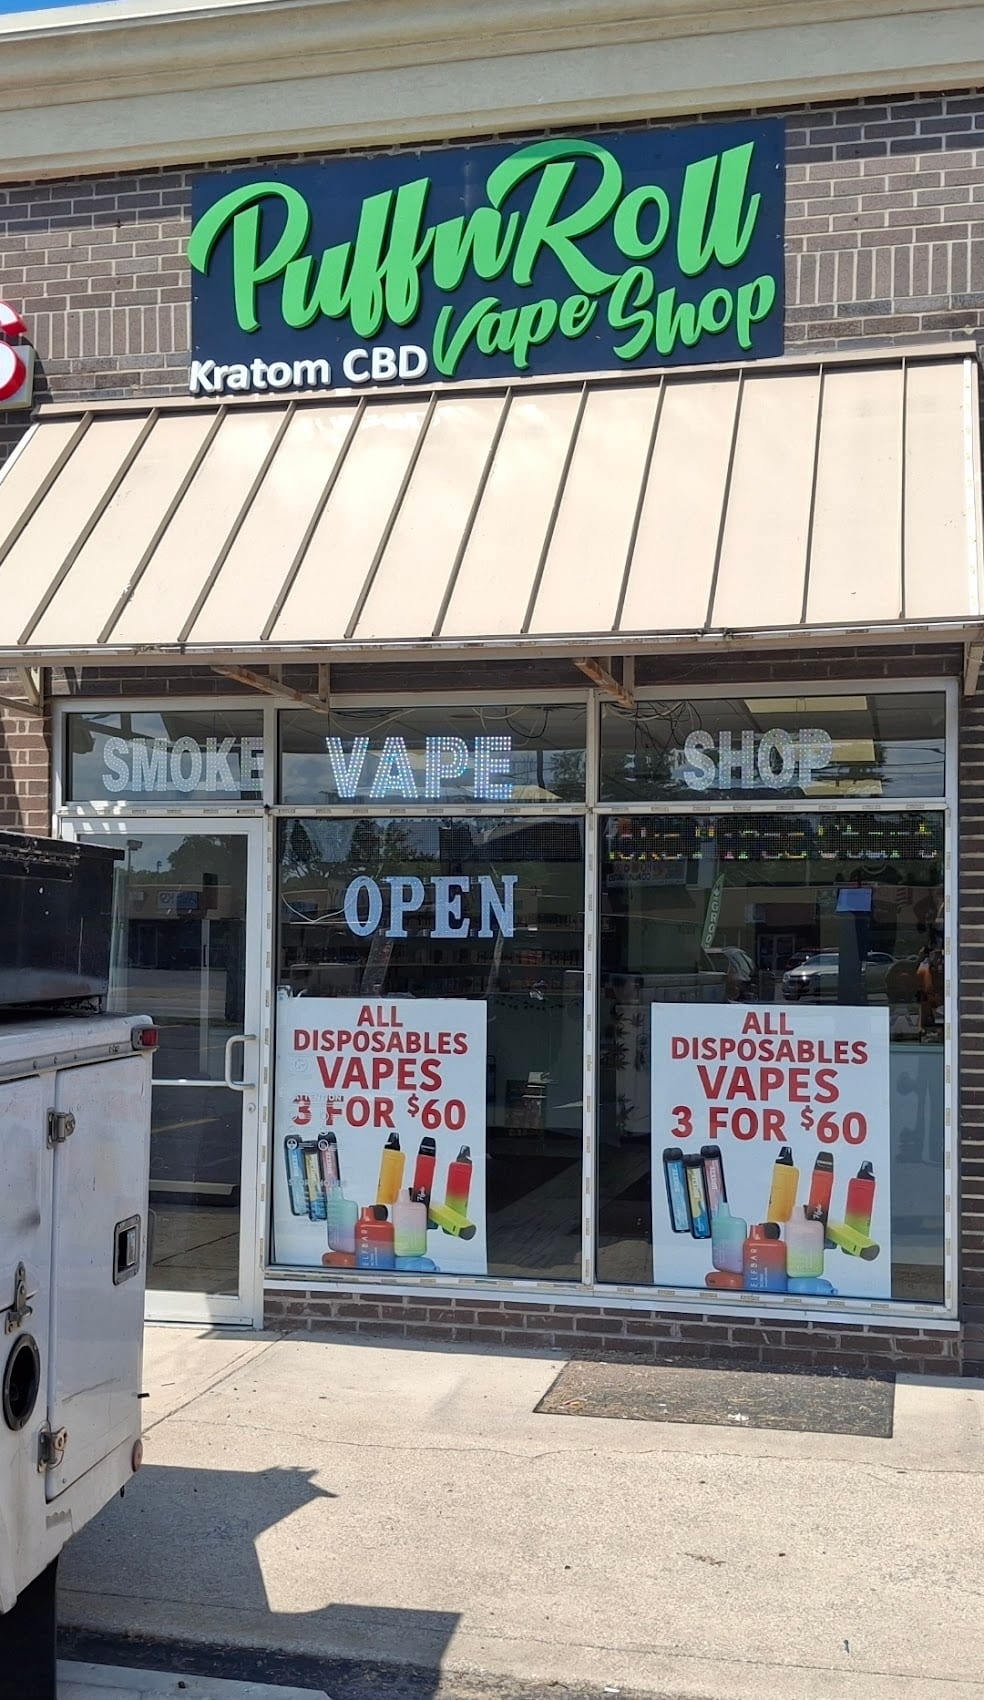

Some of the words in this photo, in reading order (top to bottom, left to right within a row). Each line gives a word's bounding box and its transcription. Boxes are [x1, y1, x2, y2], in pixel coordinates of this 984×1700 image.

[432, 294, 598, 377] Vape
[608, 265, 776, 361] Shop
[189, 354, 331, 394] Kratom
[343, 345, 429, 383] CBD
[102, 736, 264, 793] SMOKE
[326, 736, 513, 799] VAPE
[682, 728, 833, 791] SHOP
[344, 875, 519, 939] OPEN
[357, 1005, 403, 1027] ALL
[742, 1011, 794, 1035] ALL
[293, 1029, 468, 1055] DISPOSABLES
[671, 1036, 868, 1065] DISPOSABLES
[316, 1056, 442, 1091] VAPES
[697, 1065, 840, 1103] VAPES
[292, 1095, 312, 1126] 3
[326, 1096, 395, 1128] FOR
[407, 1093, 467, 1130] $60
[671, 1106, 693, 1138] 3
[709, 1106, 787, 1141] FOR
[800, 1105, 867, 1144] $60
